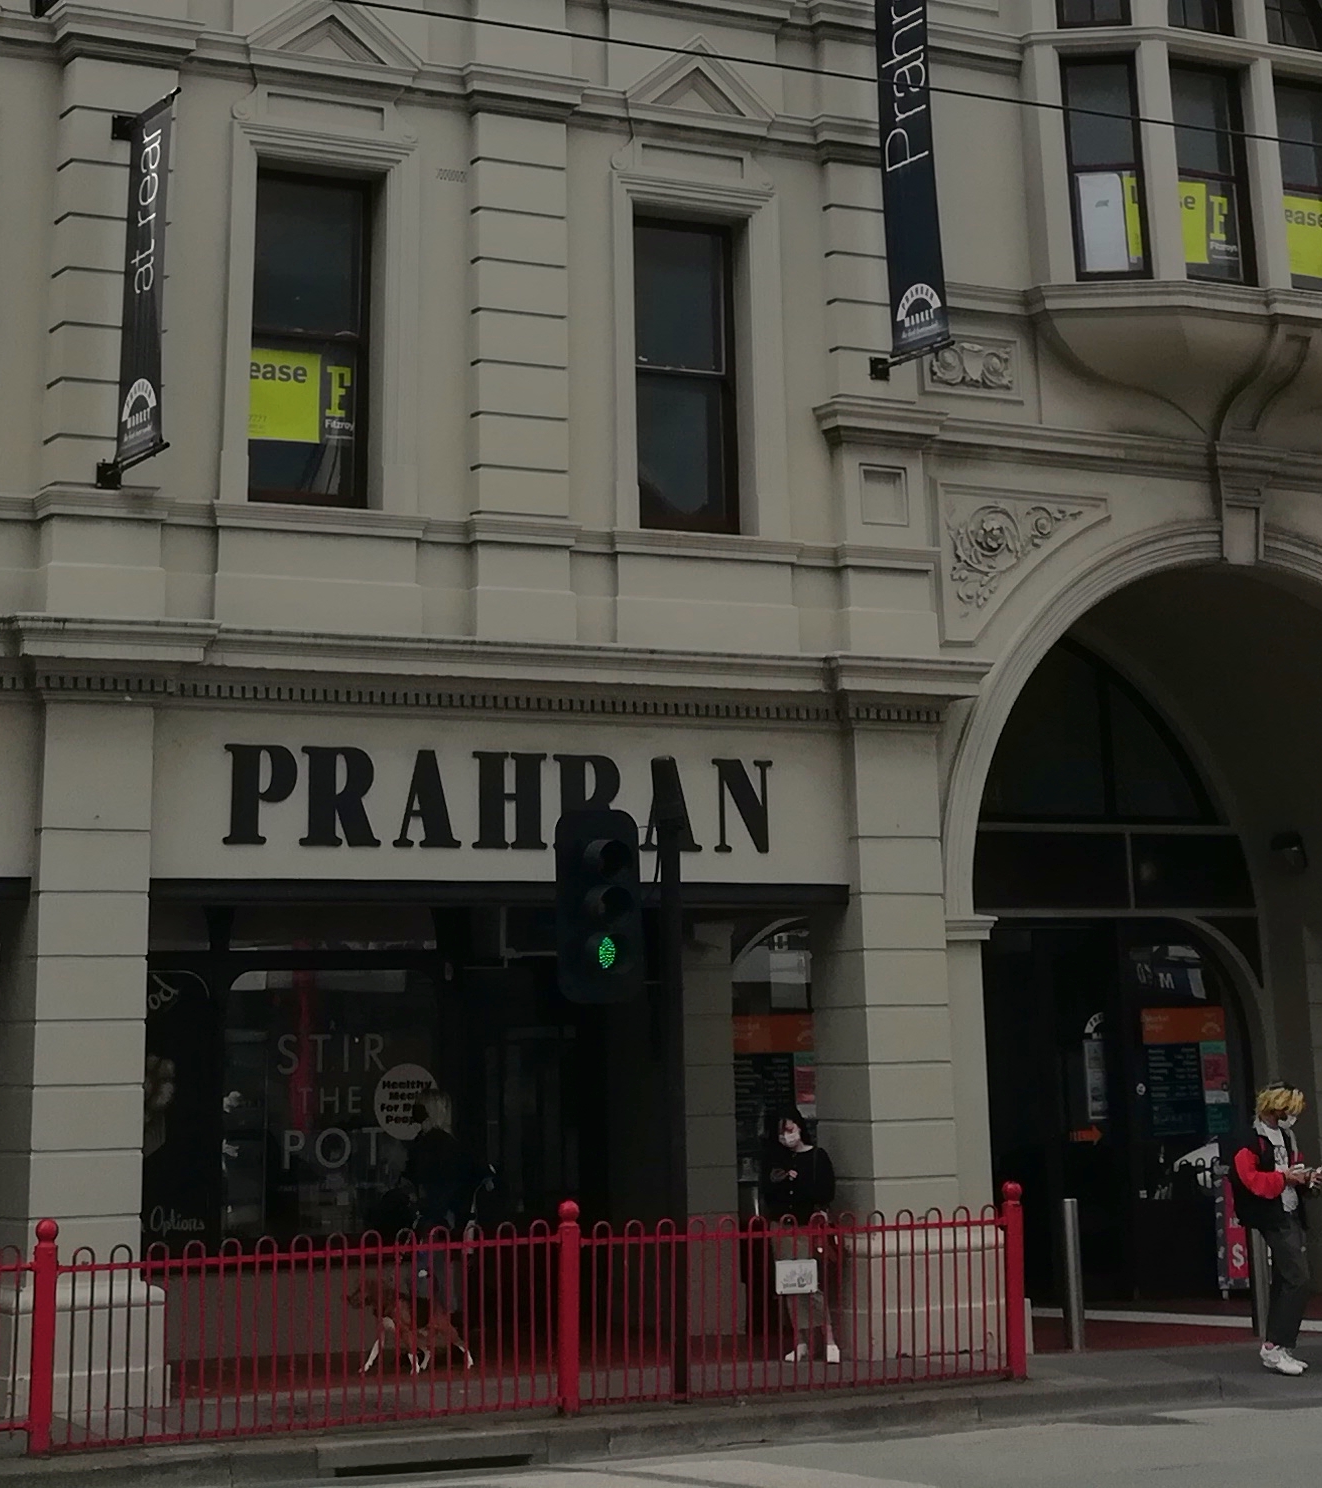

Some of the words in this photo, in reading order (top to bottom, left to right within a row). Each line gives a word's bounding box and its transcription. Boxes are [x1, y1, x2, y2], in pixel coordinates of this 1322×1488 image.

[138, 128, 162, 228] rear
[131, 239, 155, 293] at
[250, 361, 307, 383] ease
[222, 742, 773, 854] PRAHRAN
[277, 1032, 388, 1075] STIR
[297, 1086, 362, 1114] THE
[382, 1080, 432, 1090] Healthy
[283, 1126, 386, 1170] POT
[150, 1205, 205, 1237] Options
